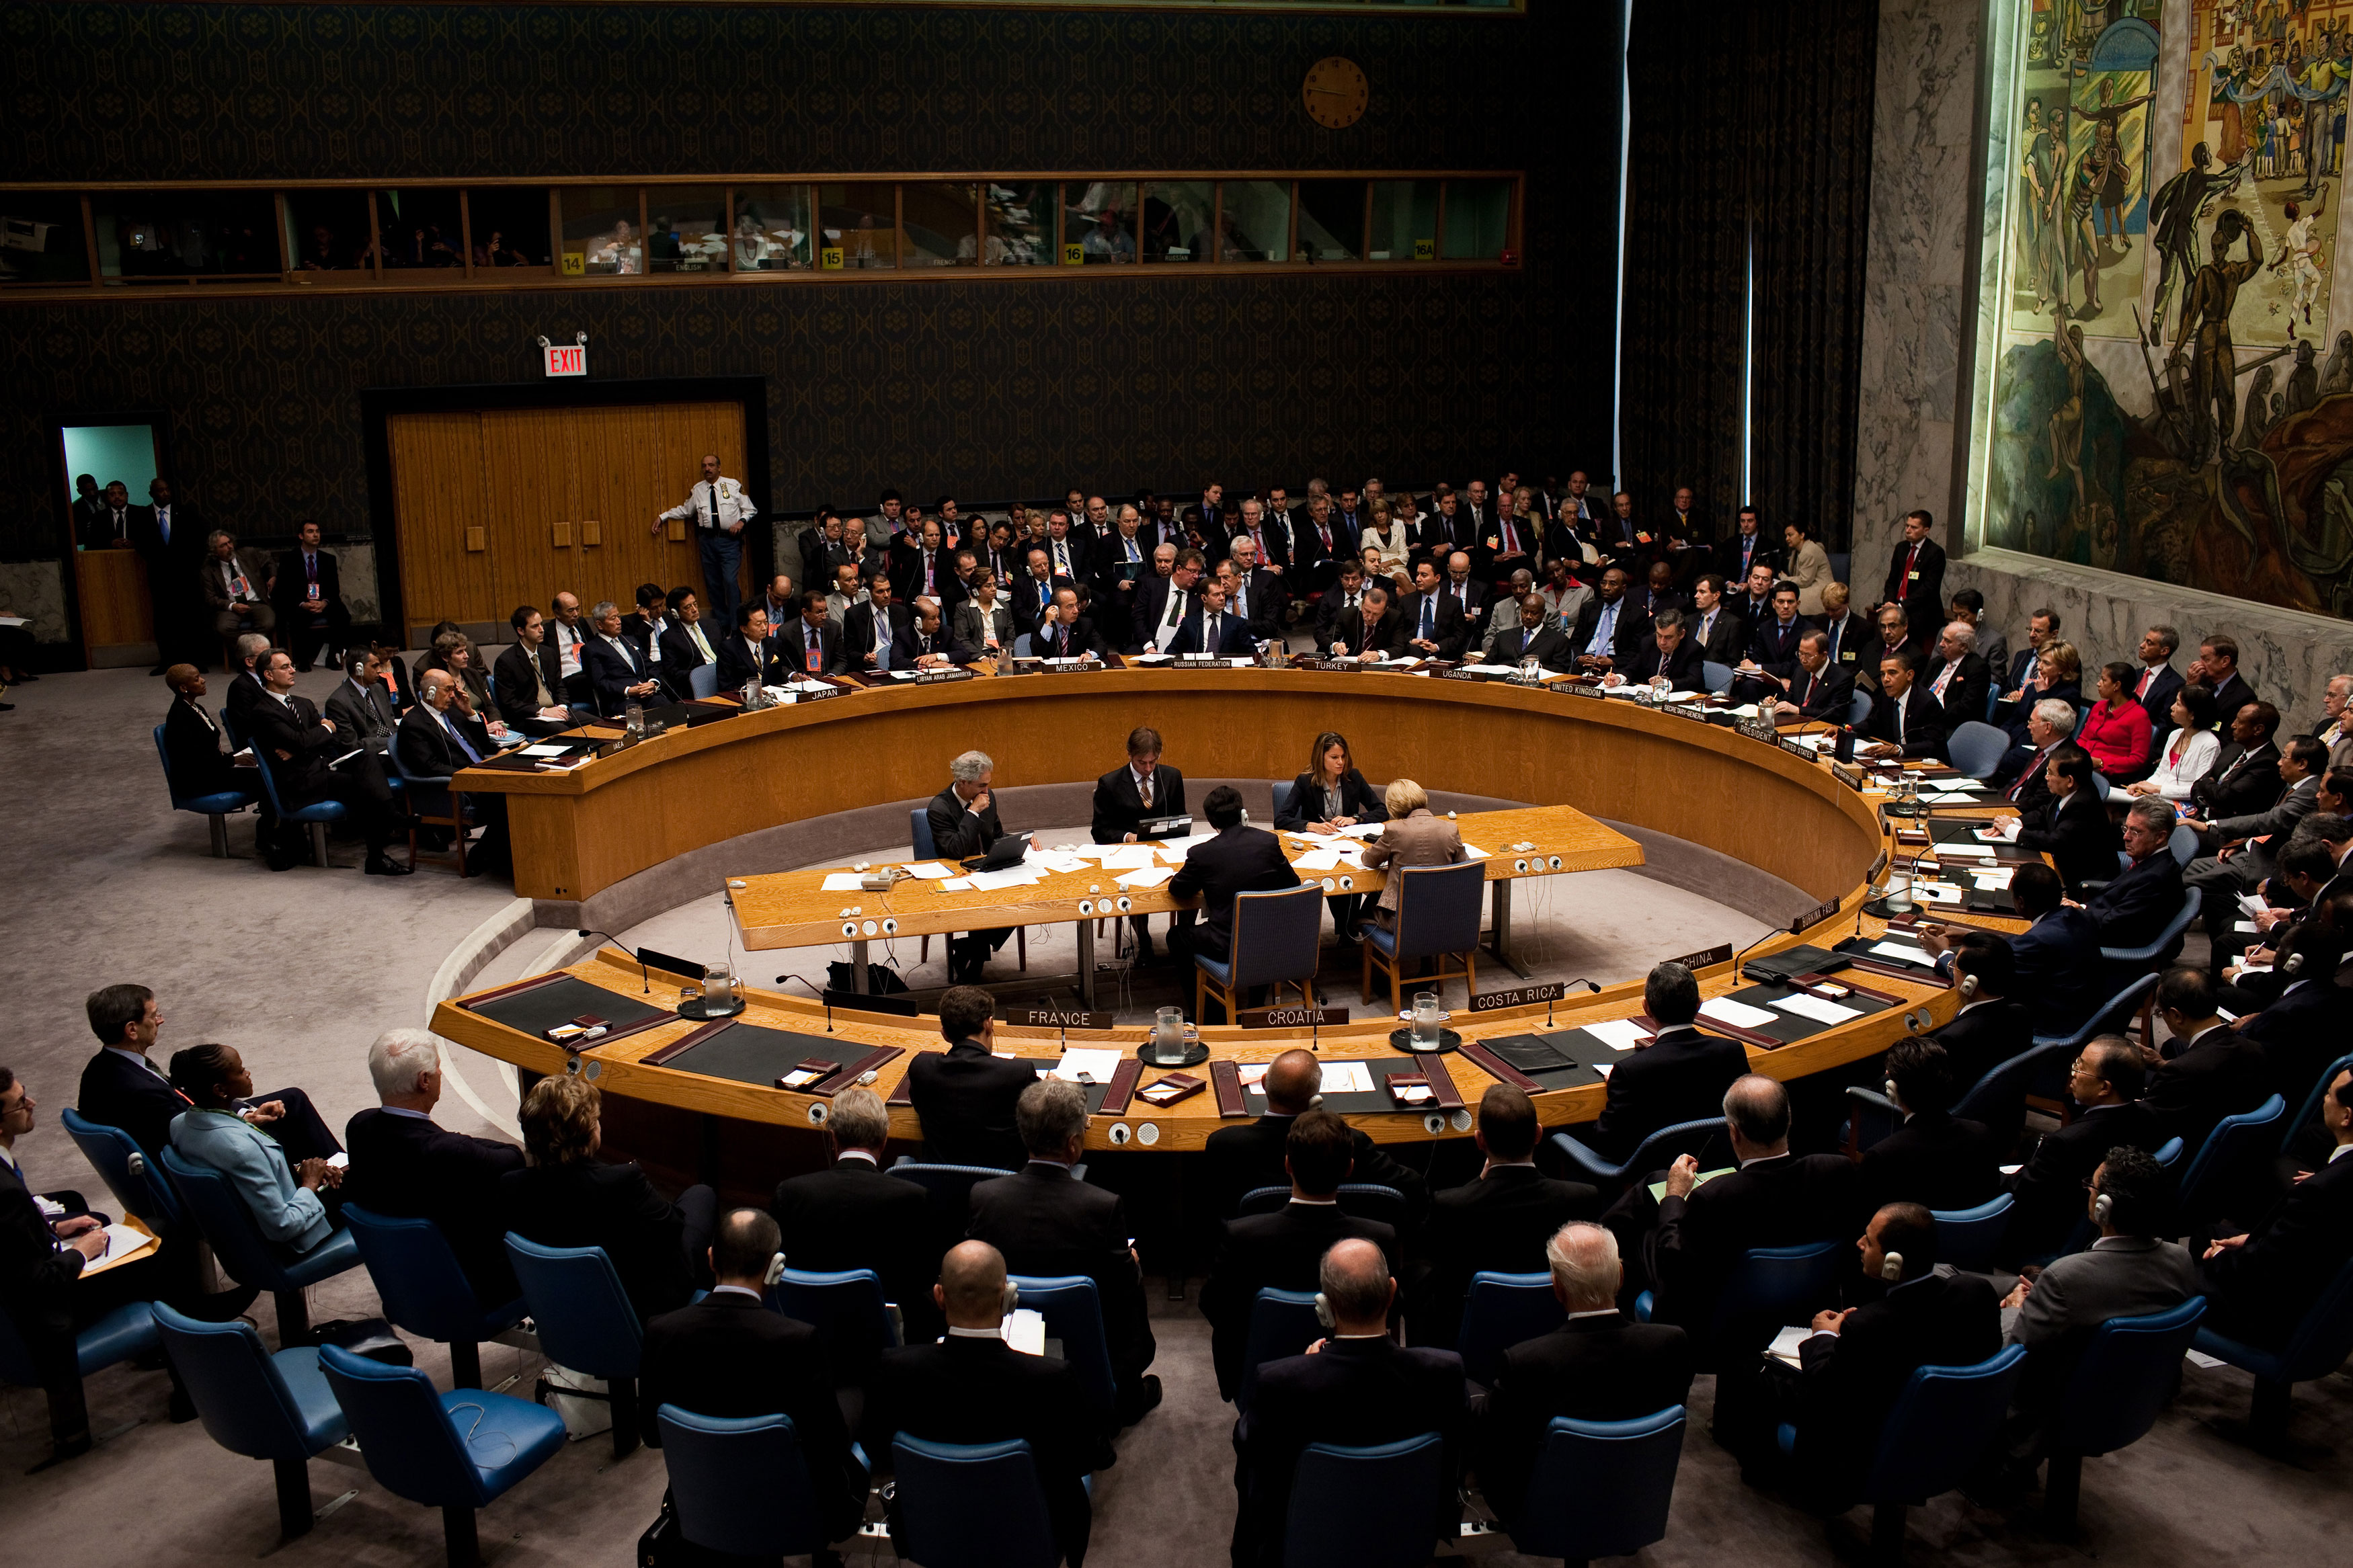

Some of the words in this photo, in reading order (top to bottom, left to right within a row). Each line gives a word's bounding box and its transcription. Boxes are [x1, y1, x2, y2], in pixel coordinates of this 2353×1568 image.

[1319, 64, 1325, 72] 11
[1332, 60, 1339, 69] 12
[1356, 74, 1361, 82] 2
[1333, 118, 1339, 126] 6
[1066, 248, 1080, 259] 16
[1415, 245, 1433, 255] 16A
[564, 257, 581, 270] 14
[826, 252, 840, 264] 15
[676, 263, 702, 272] ENGLISH
[550, 349, 582, 373] EXIT
[1055, 663, 1088, 672] MEXICO
[1314, 661, 1349, 671] TURKEY
[916, 675, 932, 683] LIBYAN
[946, 671, 972, 679] JAMAHIRIYA
[1442, 670, 1472, 679] UGANDA
[811, 688, 838, 700] JAPAN
[1552, 682, 1573, 693] UNITED
[1574, 686, 1601, 697] KINGDOM
[1663, 704, 1706, 722] SECRETARY-GENERAL
[1740, 725, 1772, 742] PRESIDENT
[612, 740, 625, 751] IAEA
[1781, 740, 1796, 752] UNITED
[1797, 747, 1813, 759] STATES
[1802, 908, 1821, 927] BURKINA
[1822, 901, 1834, 917] FASO
[1682, 951, 1714, 968] CHINA
[1478, 991, 1520, 1009] COSTA
[1527, 985, 1558, 1001] RICA
[1029, 1010, 1090, 1026] FRANCE
[1268, 1009, 1324, 1025] CROATIA
